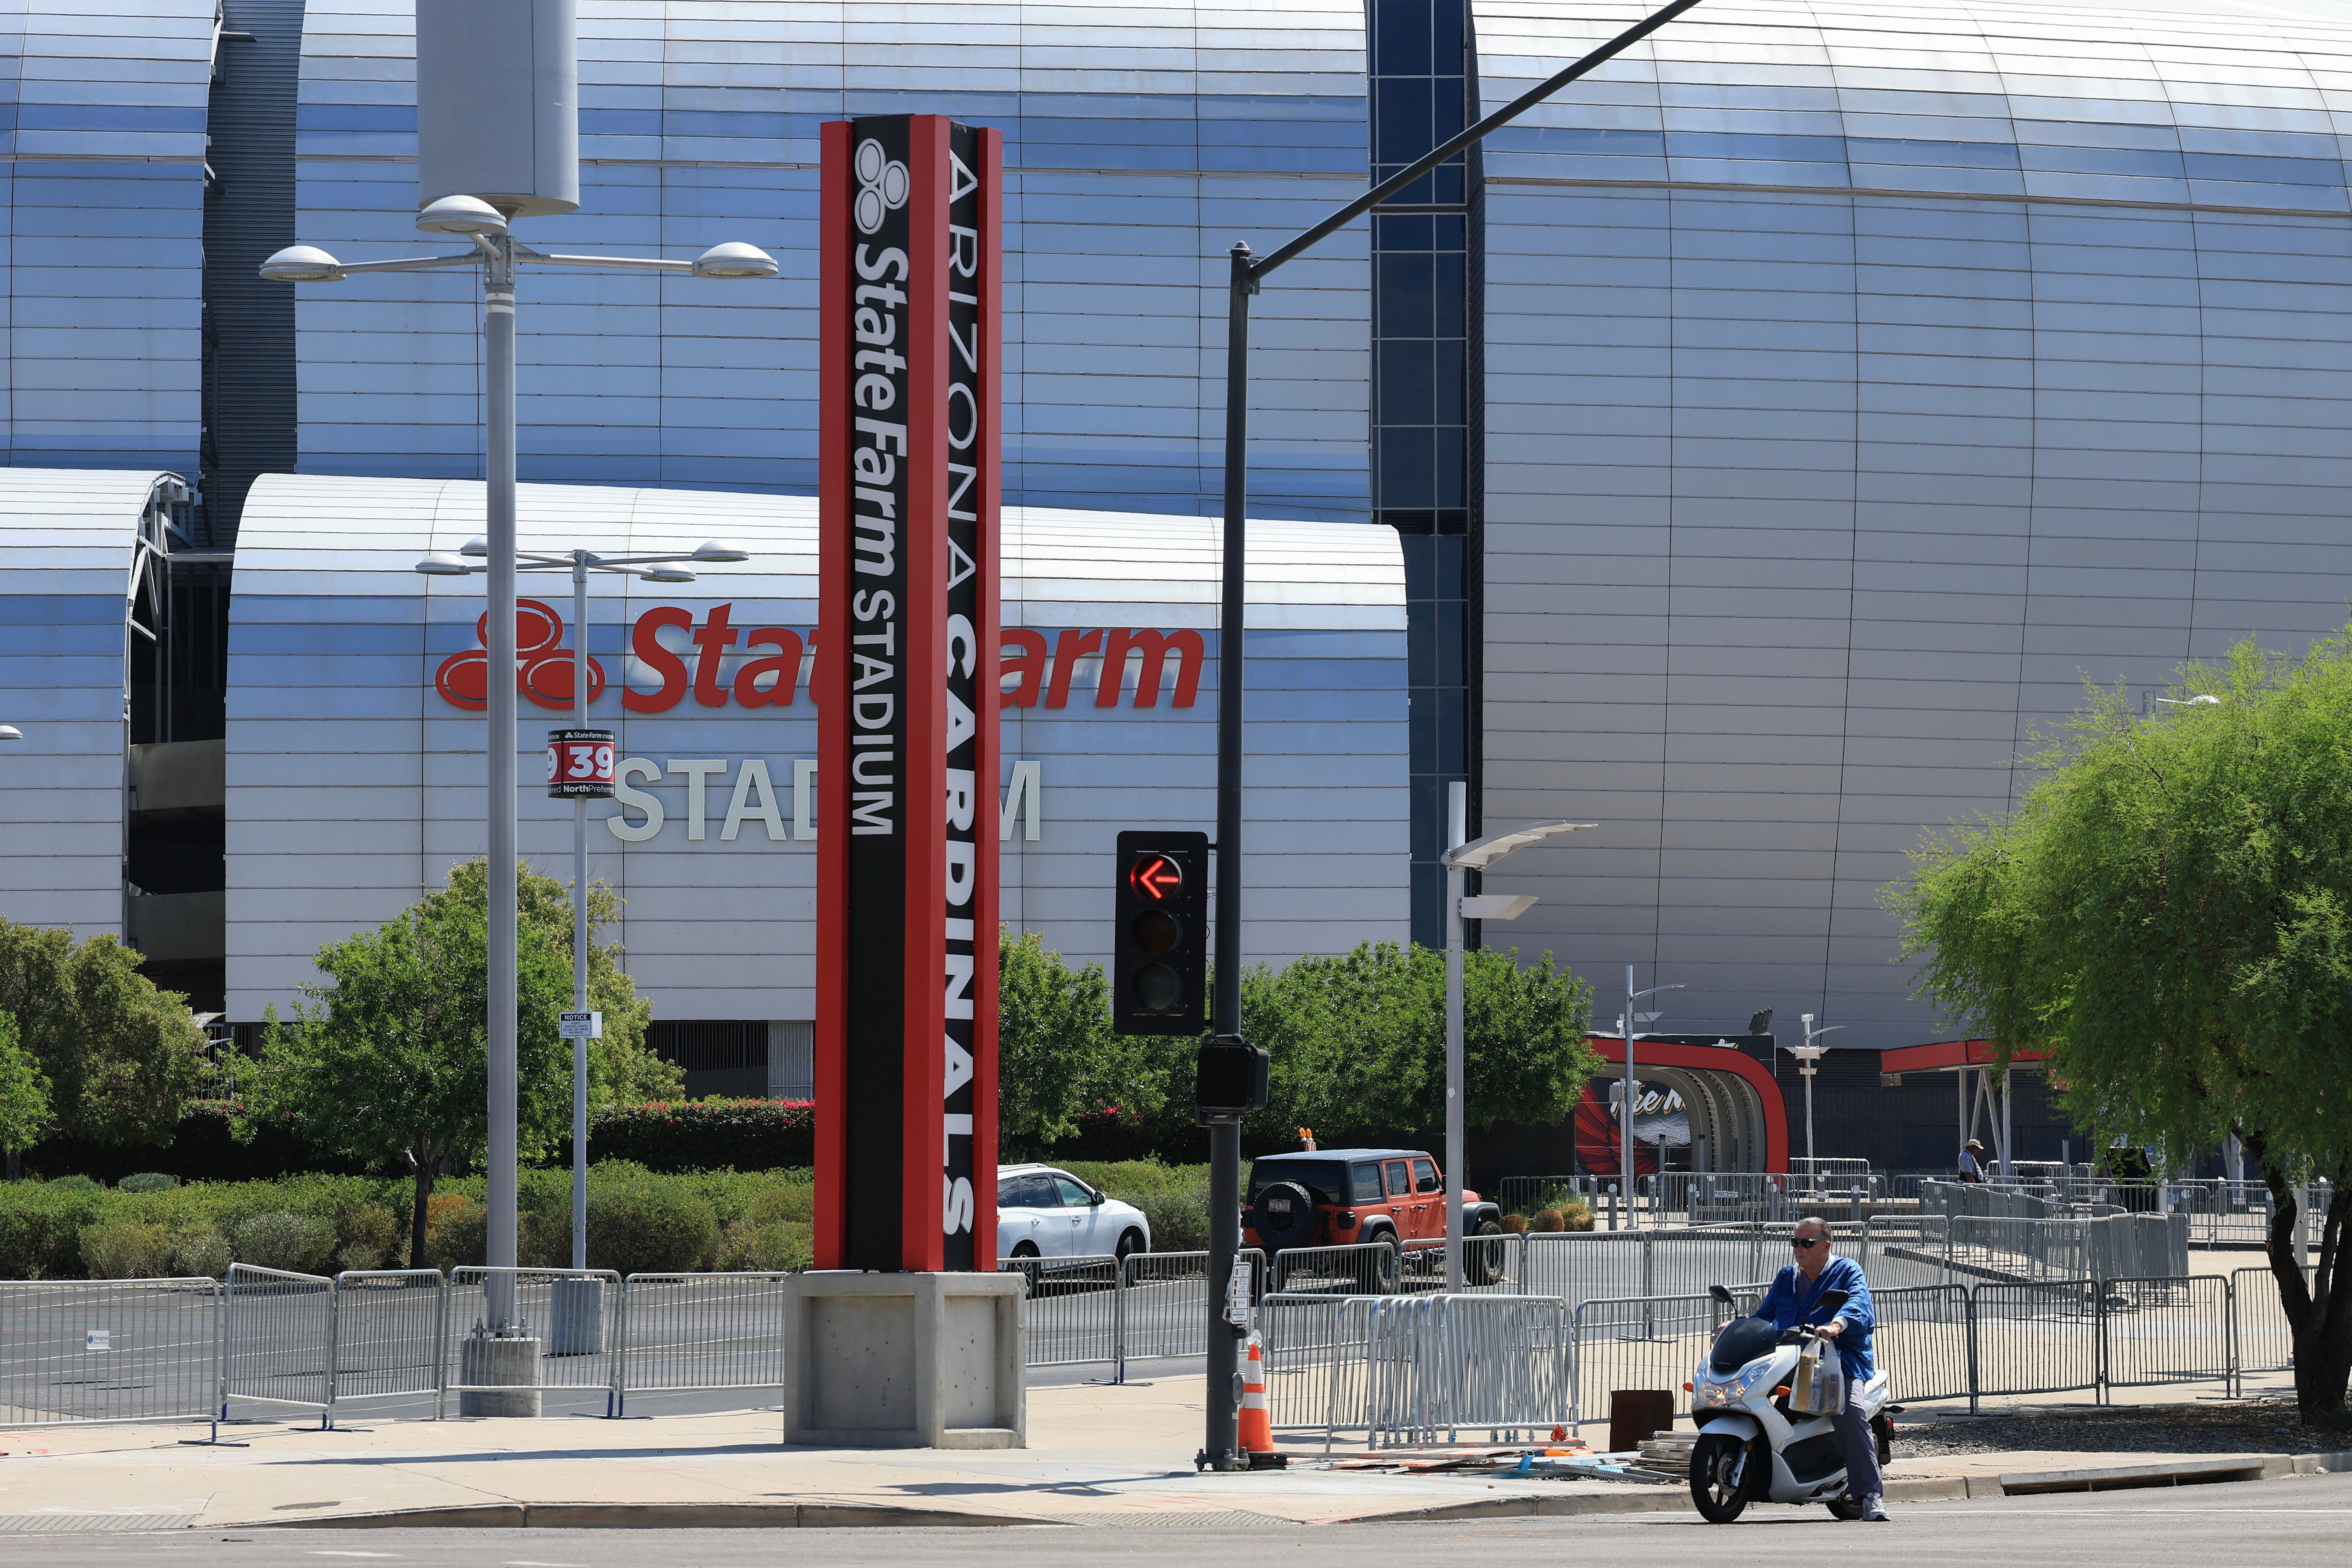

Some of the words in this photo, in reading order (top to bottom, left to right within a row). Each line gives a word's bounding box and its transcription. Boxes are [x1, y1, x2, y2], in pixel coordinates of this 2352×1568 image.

[947, 148, 978, 593] ARIZONA
[568, 746, 613, 779] 39
[852, 589, 896, 835] STADIUM
[943, 613, 976, 1236] CARDINALS
